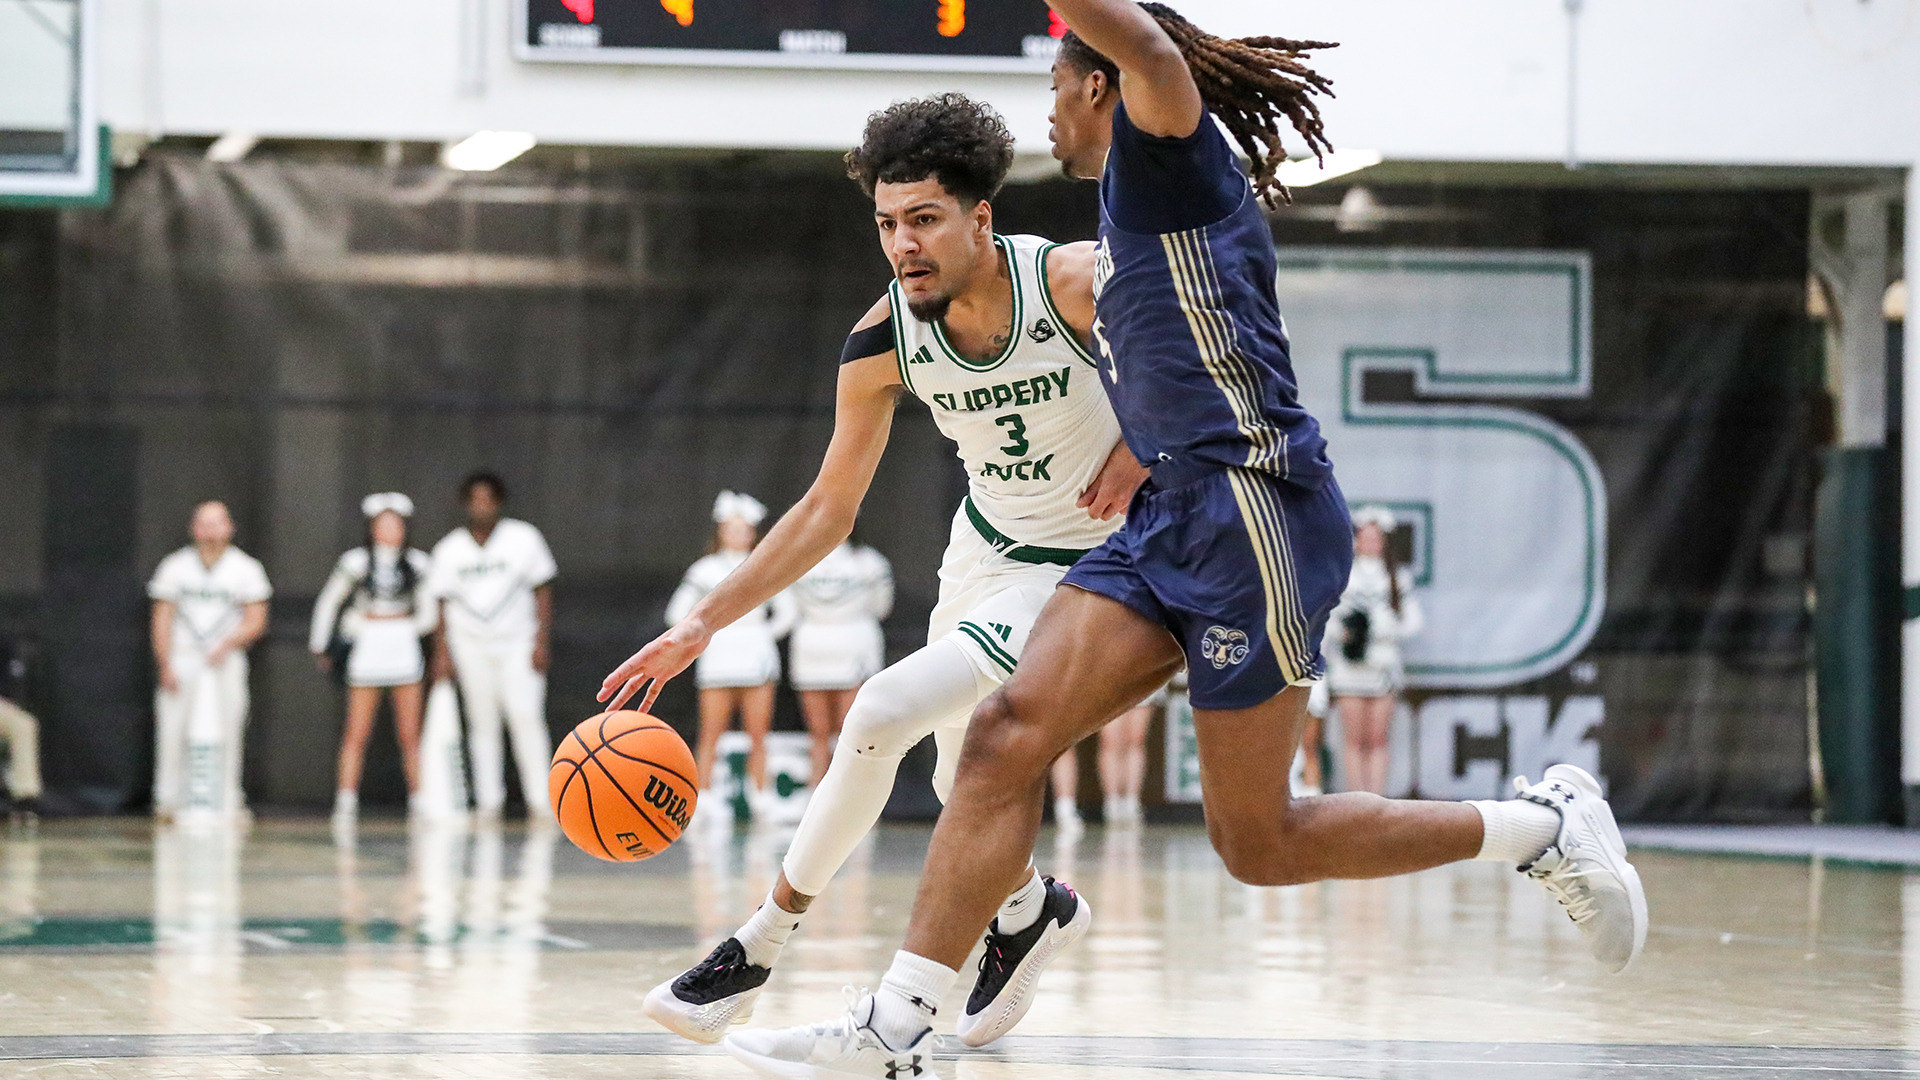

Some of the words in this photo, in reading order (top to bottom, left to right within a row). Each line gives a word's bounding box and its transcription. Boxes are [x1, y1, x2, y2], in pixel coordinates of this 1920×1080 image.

[932, 366, 1071, 411] SLIPPERY
[995, 413, 1029, 457] 3
[643, 774, 691, 832] Wilso
